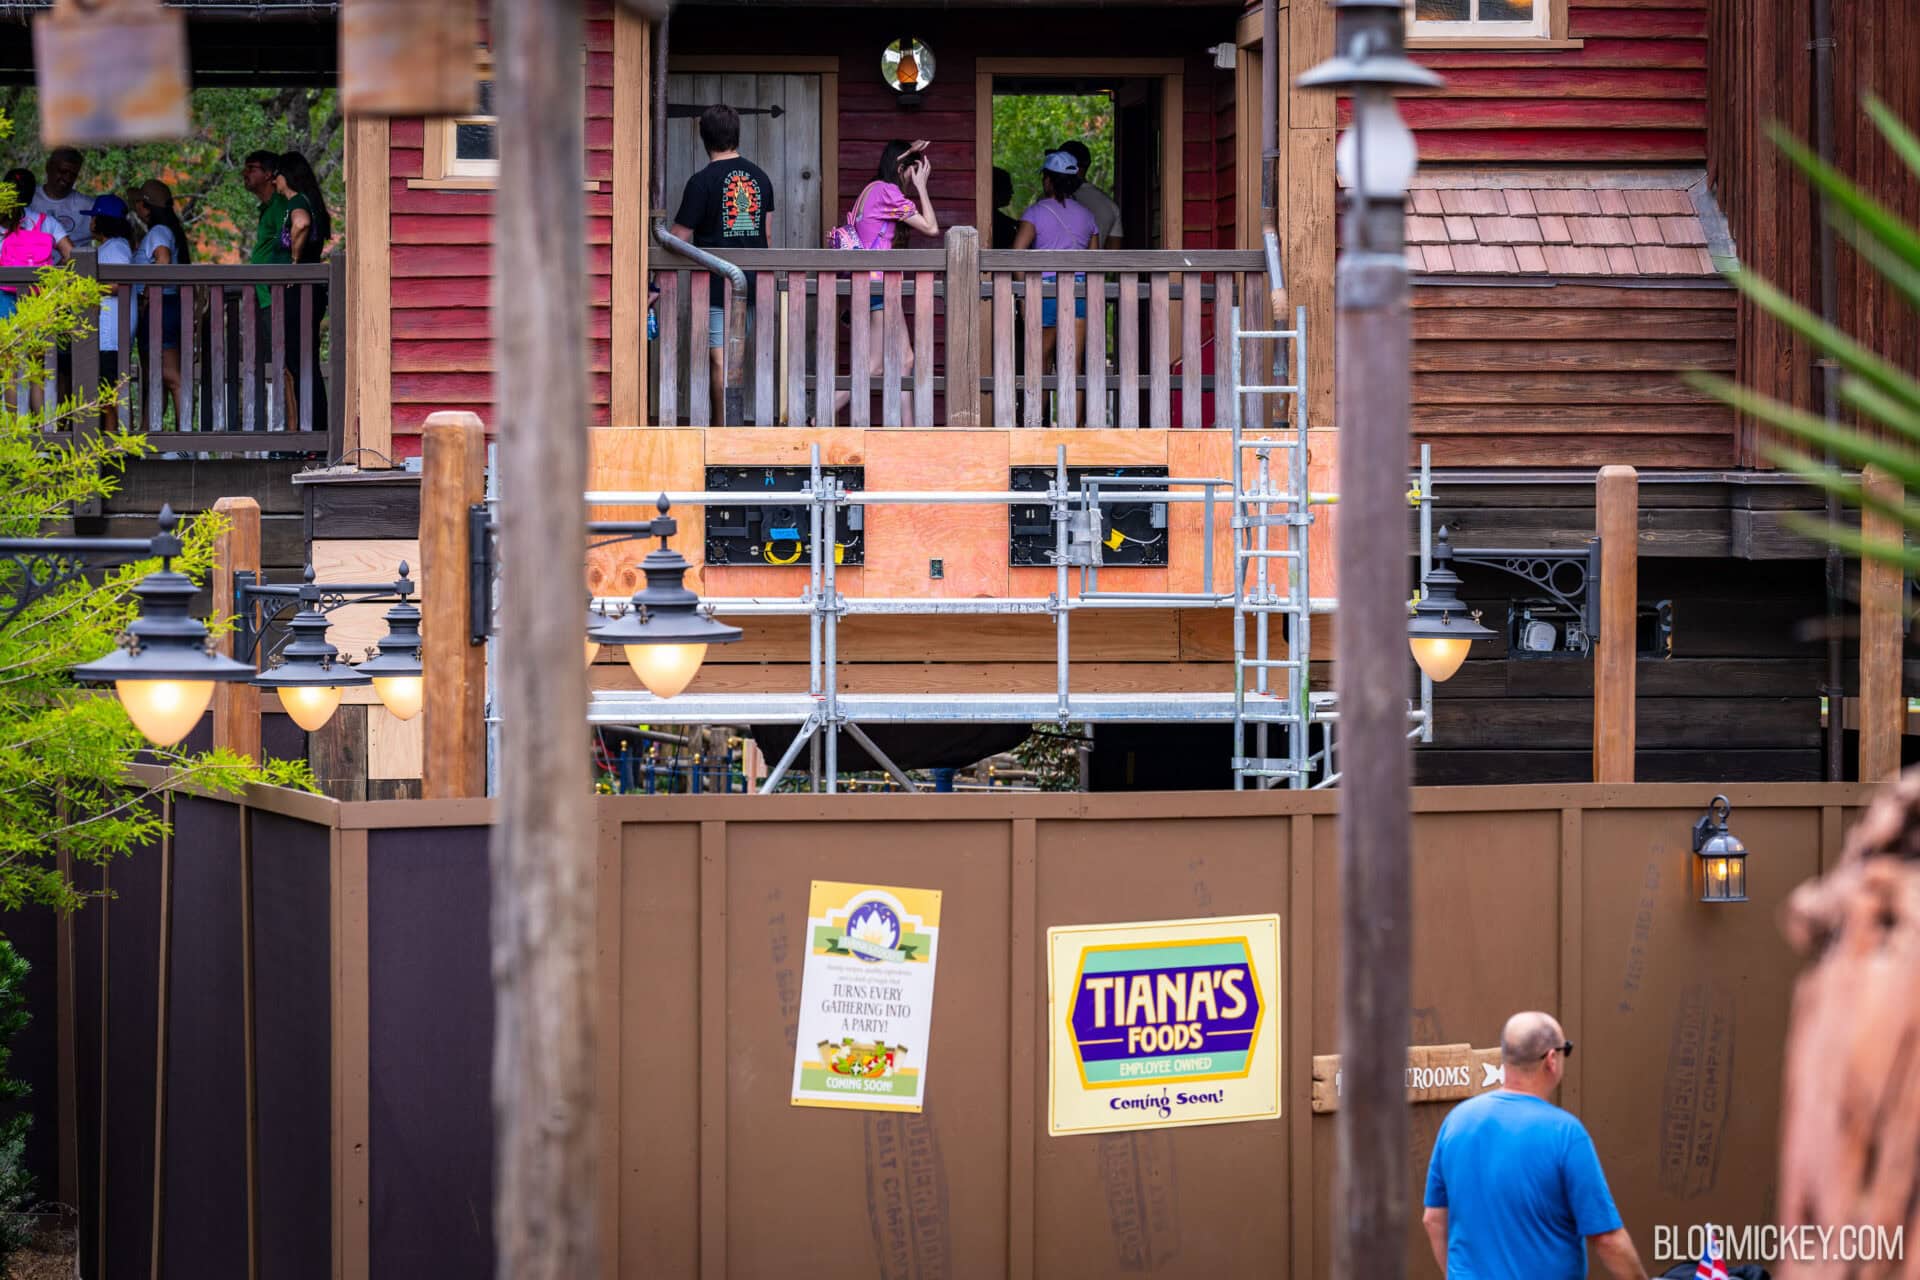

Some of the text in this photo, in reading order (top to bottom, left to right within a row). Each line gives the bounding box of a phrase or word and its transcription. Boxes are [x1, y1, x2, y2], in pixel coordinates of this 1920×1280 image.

[832, 983, 904, 1001] TURNS EVERY
[1085, 968, 1248, 1029] TIANA'S
[821, 999, 911, 1018] GATHERING INTO
[841, 1017, 889, 1033] A PARTY!
[1127, 1022, 1204, 1054] FOODS
[1119, 1056, 1213, 1077] EMPLOYEE OWNED
[825, 1076, 894, 1093] COMING SOON!
[1109, 1087, 1224, 1119] Coming Soon!
